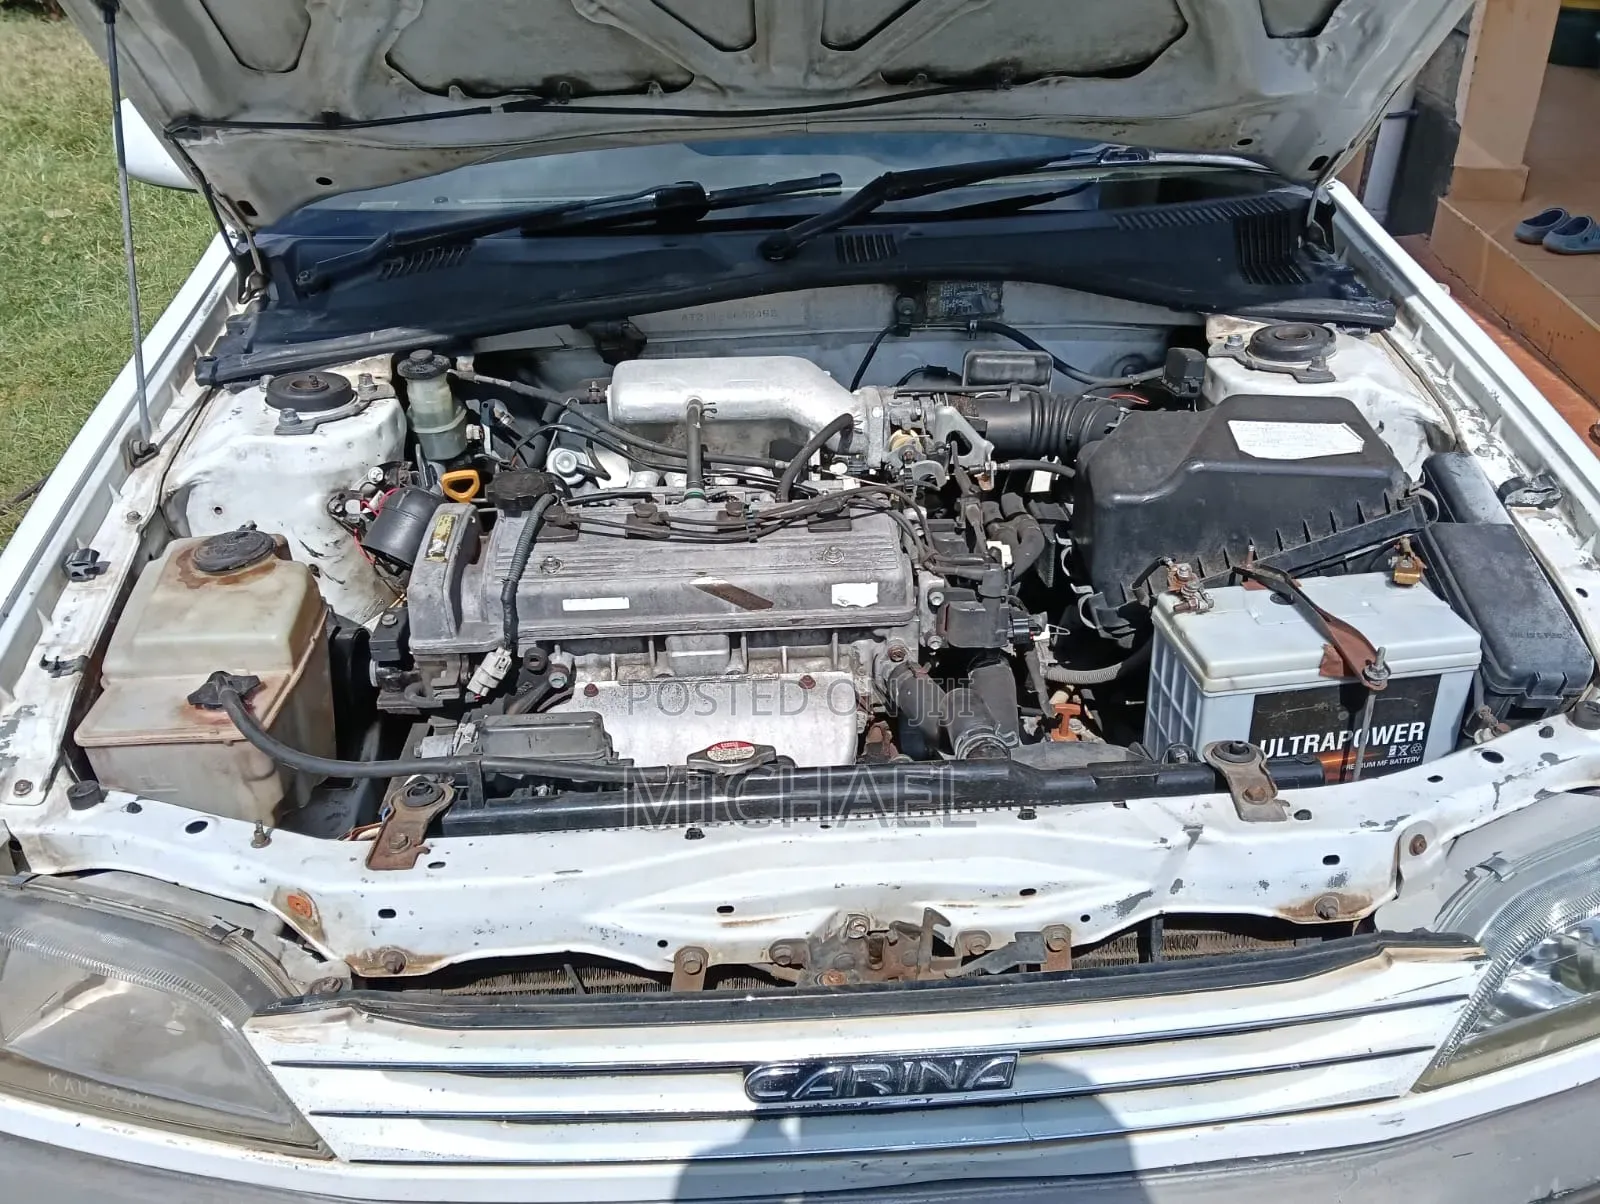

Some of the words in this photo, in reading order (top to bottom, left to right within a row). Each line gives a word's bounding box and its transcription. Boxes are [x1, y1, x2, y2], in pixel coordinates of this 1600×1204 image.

[1260, 722, 1426, 759] ULTRAPOWER
[1342, 761, 1376, 772] PREIUM
[1376, 759, 1389, 767] MF
[1389, 755, 1421, 765] BATTERY
[48, 1072, 89, 1097] KAU
[745, 1055, 1017, 1102] CARINA
